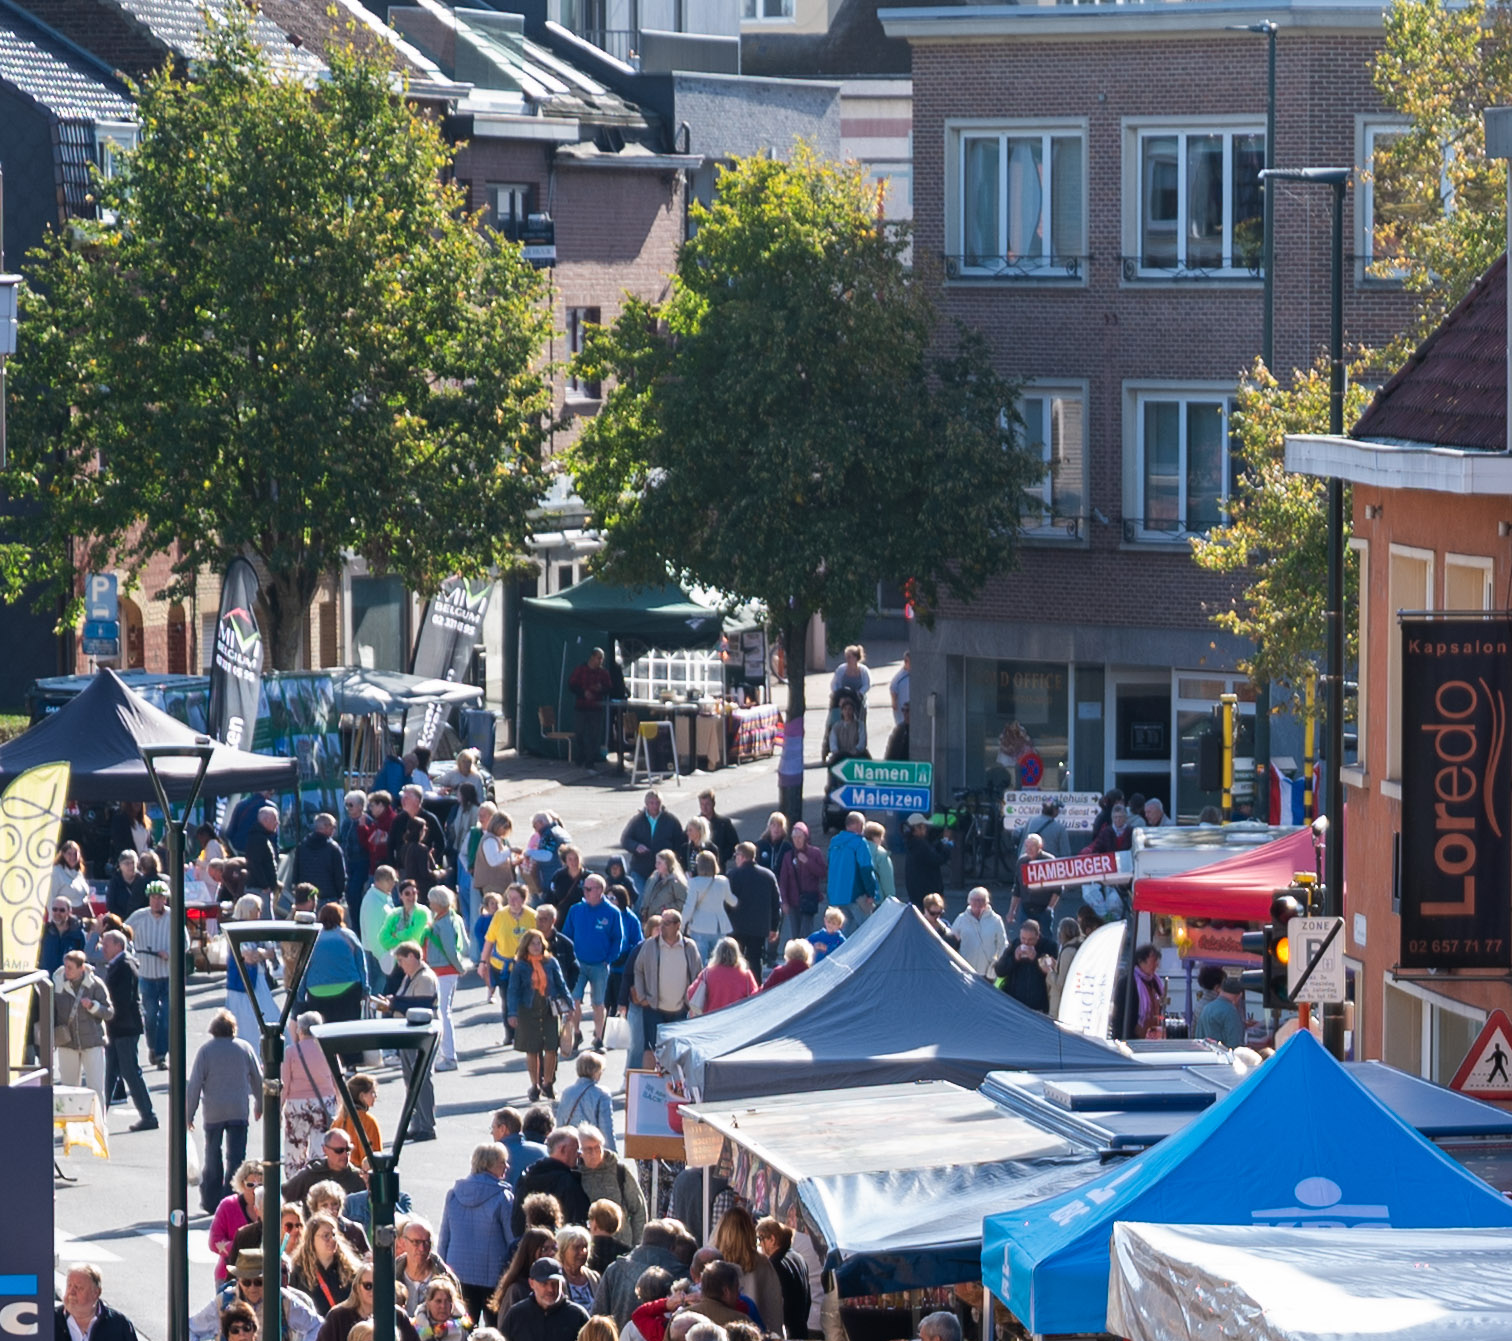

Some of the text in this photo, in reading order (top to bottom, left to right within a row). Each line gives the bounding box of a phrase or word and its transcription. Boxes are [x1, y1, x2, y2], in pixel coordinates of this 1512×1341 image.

[92, 576, 110, 602] P
[1408, 639, 1507, 657] Kapsalon
[854, 761, 909, 782] Namen
[852, 788, 922, 808] Maleizen
[1420, 680, 1477, 915] Loredo
[1027, 856, 1112, 883] HAMBURGER
[1302, 921, 1330, 930] ZONE
[1409, 938, 1502, 953] 02 657 71 77
